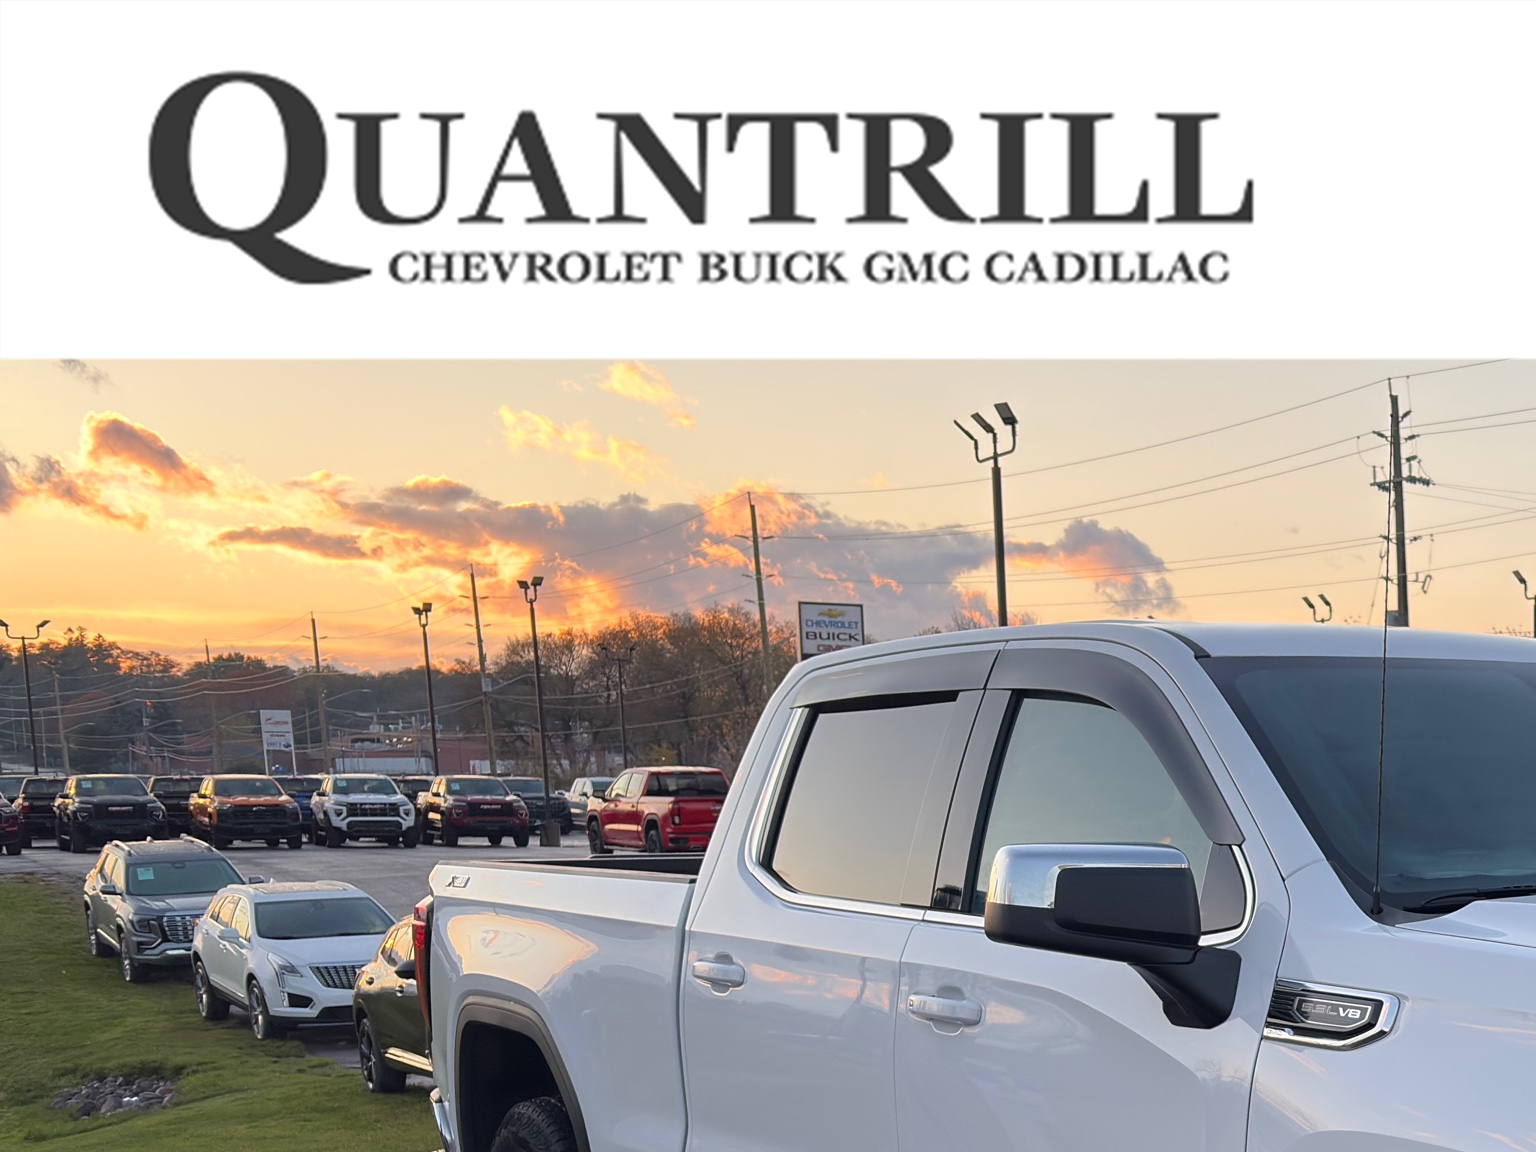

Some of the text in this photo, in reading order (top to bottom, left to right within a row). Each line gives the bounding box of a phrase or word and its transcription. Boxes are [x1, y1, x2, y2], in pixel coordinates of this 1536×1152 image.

[805, 619, 859, 630] CHEVROLET
[805, 631, 860, 642] BUICK
[1338, 1007, 1362, 1019] V8
